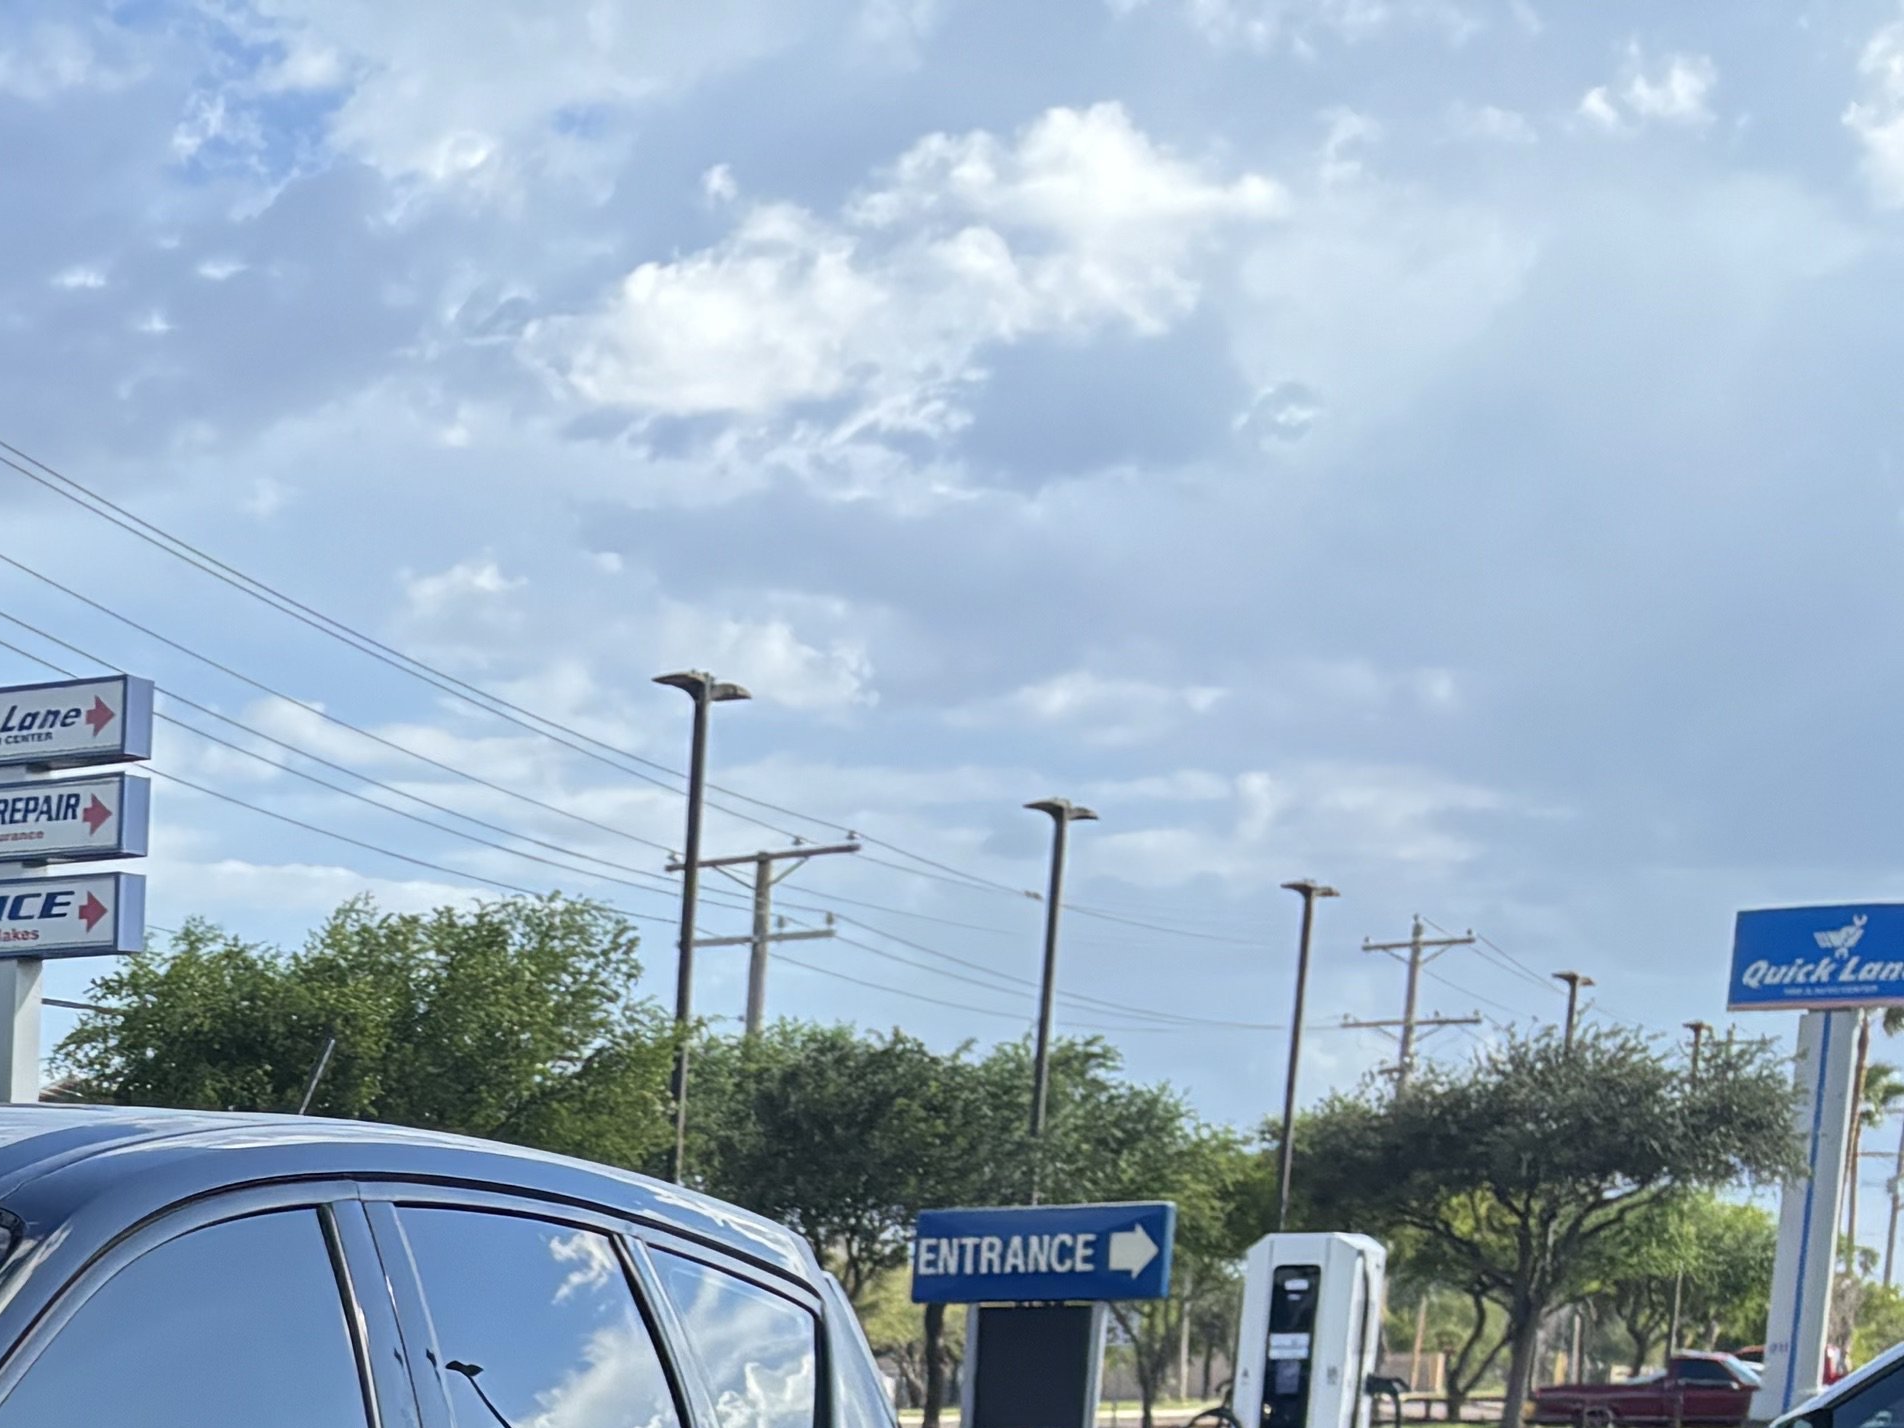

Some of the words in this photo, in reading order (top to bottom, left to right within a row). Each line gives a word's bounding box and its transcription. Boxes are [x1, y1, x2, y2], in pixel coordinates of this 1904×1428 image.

[0, 705, 81, 733] Lane
[4, 732, 53, 745] CENTER
[1742, 956, 1836, 989] Quick
[1838, 955, 1904, 983] Lan
[917, 1232, 1097, 1276] ENTRANCE
